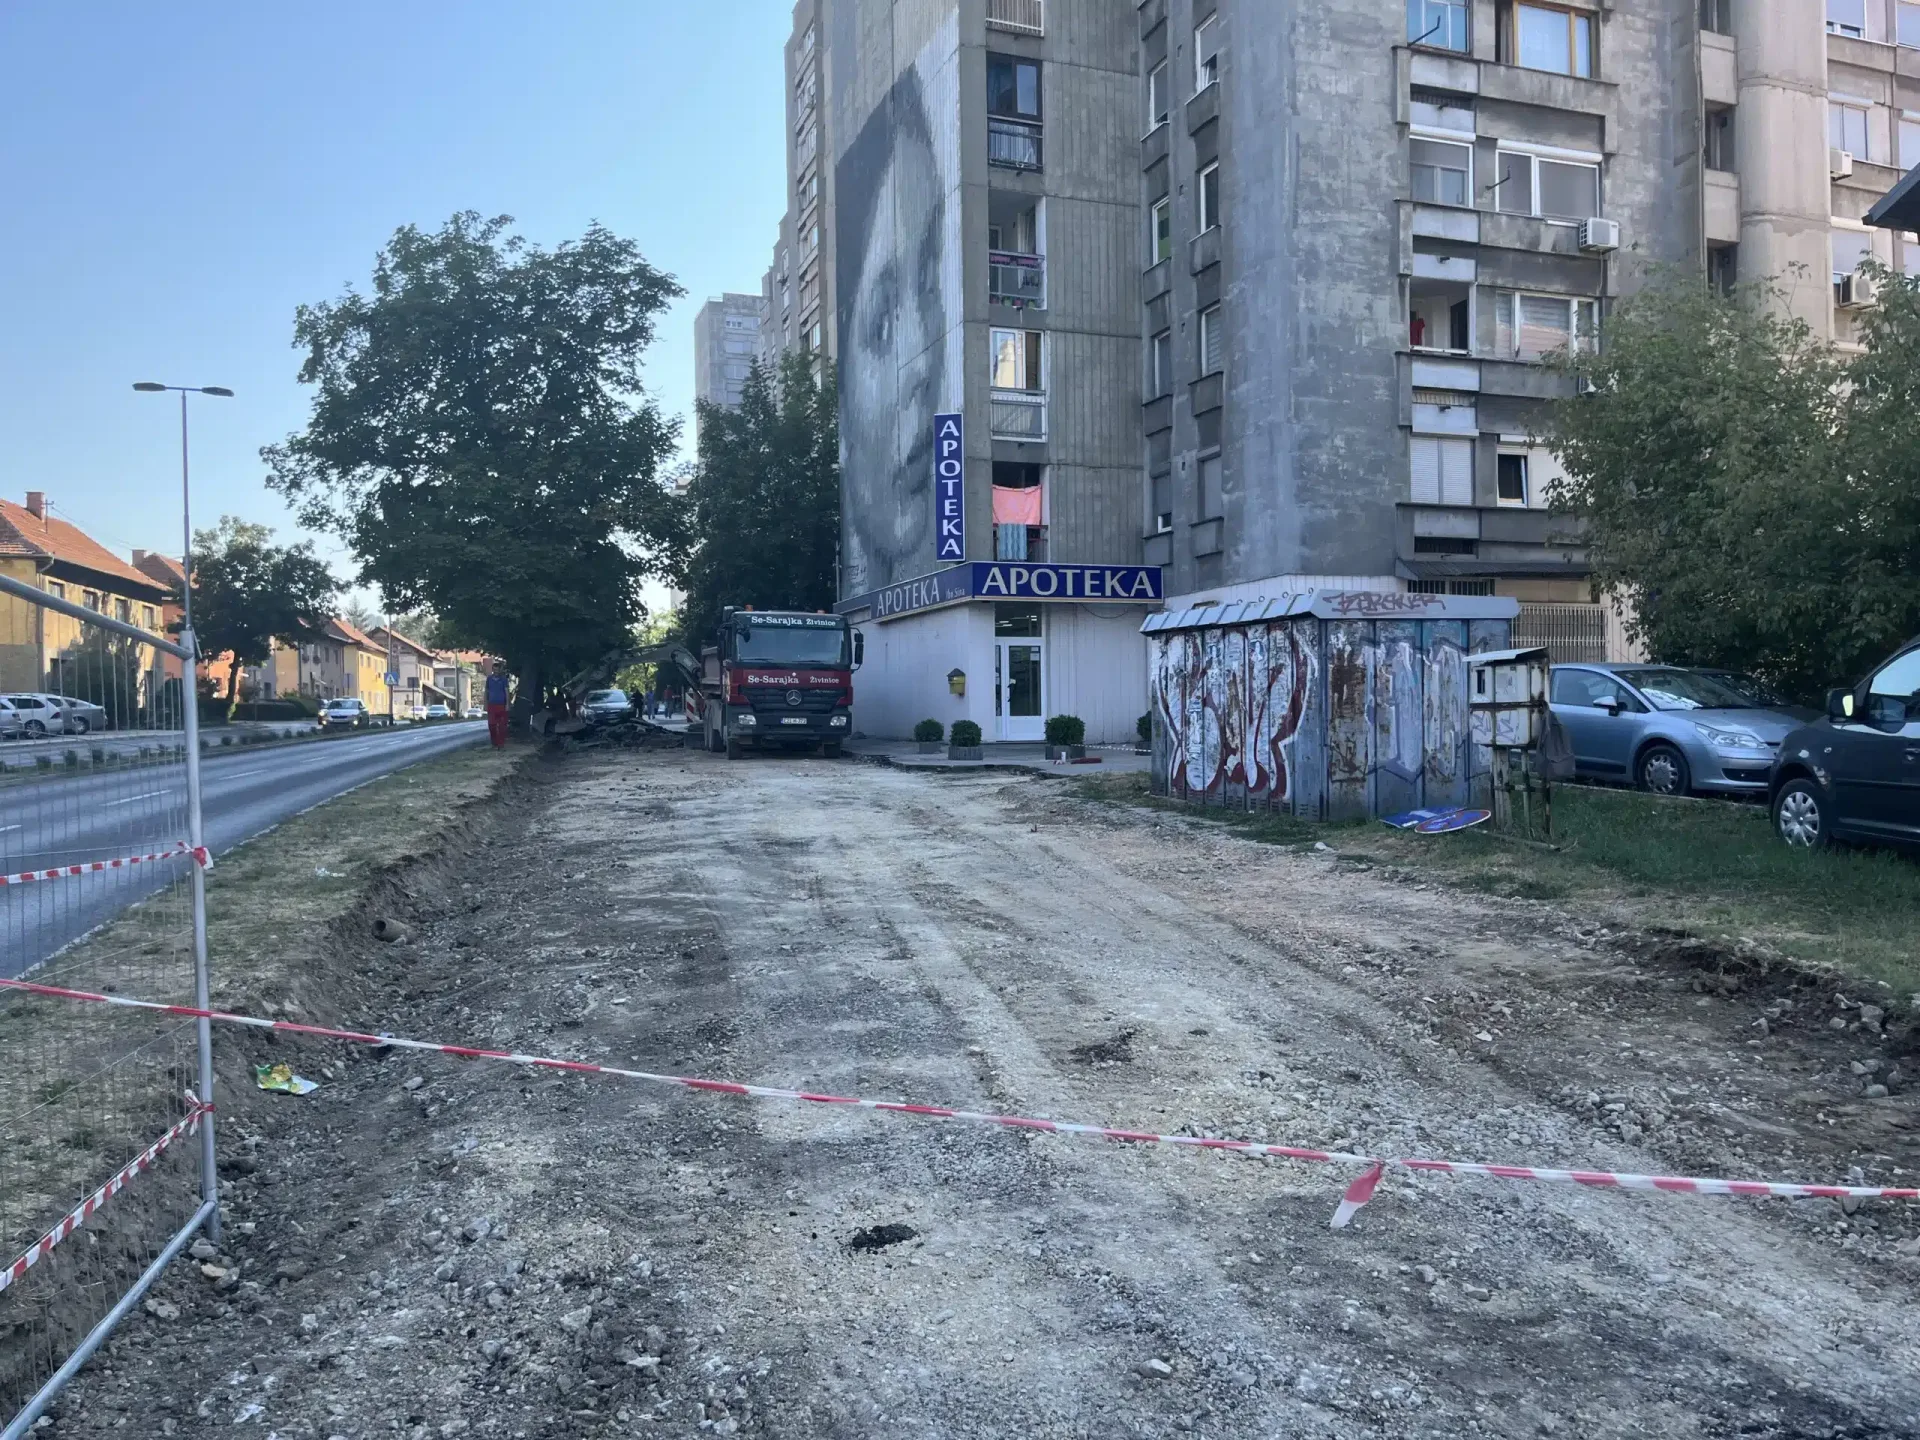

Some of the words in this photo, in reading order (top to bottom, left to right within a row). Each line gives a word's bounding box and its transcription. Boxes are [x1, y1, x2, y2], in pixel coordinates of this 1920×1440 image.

[939, 420, 962, 556] APOTEKA
[876, 577, 940, 617] APOTEKA
[981, 566, 1155, 598] APOTEKA
[751, 616, 802, 626] Se-Sarajka
[748, 675, 799, 685] Se-Sarajka
